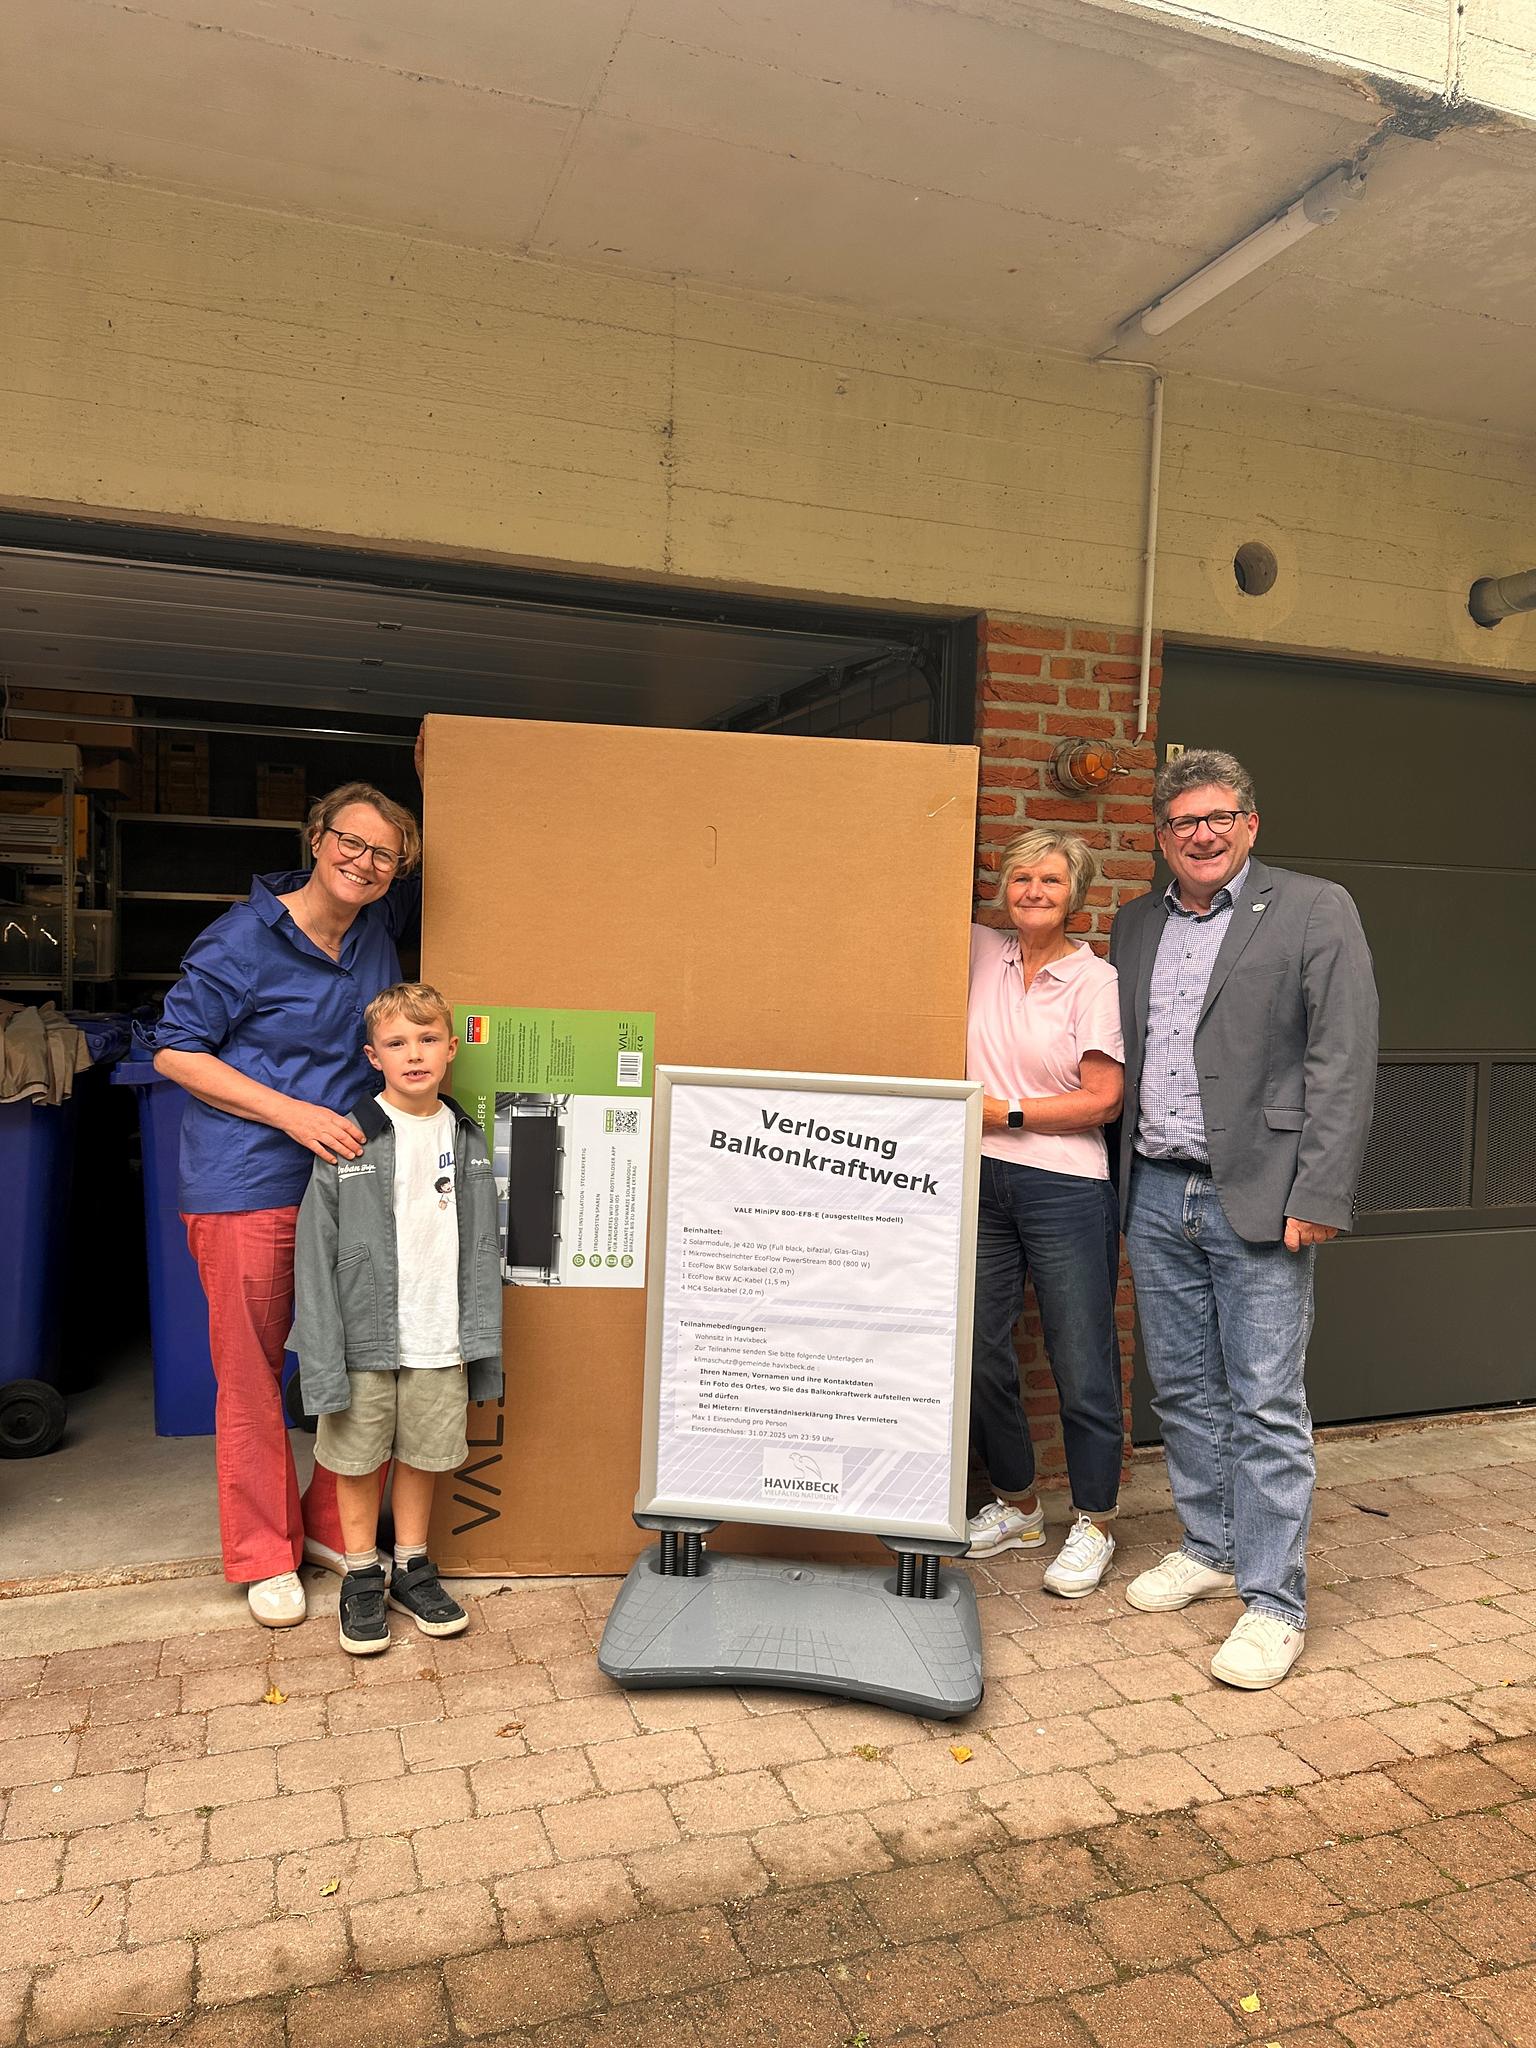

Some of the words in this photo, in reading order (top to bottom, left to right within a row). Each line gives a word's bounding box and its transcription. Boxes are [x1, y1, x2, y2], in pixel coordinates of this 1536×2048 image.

[619, 1023, 628, 1050] VALE
[762, 1109, 898, 1160] Verlosung
[710, 1129, 939, 1195] Balkonkraftwerk
[755, 1208, 779, 1216] MiniPV
[781, 1210, 819, 1218] 800-EF8-E
[822, 1213, 873, 1222] (ausgestelltes
[876, 1216, 903, 1224] Modell)
[683, 1227, 723, 1235] Beinhaltet:
[689, 1238, 732, 1248] Solarmodule,
[807, 1246, 832, 1254] bifazial,
[834, 1248, 869, 1257] Glas-Glas)
[689, 1250, 752, 1260] Mikrowechselrichter
[755, 1254, 780, 1262] EcoFlow
[783, 1256, 826, 1265] PowerStream
[843, 1260, 859, 1268] (800
[688, 1262, 714, 1270] EcoFlow
[733, 1265, 768, 1273] Solarkabel
[688, 1273, 713, 1281] EcoFlow
[733, 1276, 763, 1284] AC-Kabel
[764, 1278, 778, 1286] (1,5
[704, 1286, 737, 1294] Solarkabel
[680, 1321, 766, 1332] Teilnahmebedingungen:
[797, 1352, 825, 1360] folgende
[827, 1355, 863, 1363] Unterlagen
[722, 1370, 749, 1378] Namen,
[752, 1372, 789, 1380] Vornamen
[824, 1377, 874, 1387] Kontaktdaten
[746, 1383, 767, 1391] Ortes,
[811, 1389, 871, 1399] Balkonkraftwerk
[874, 1394, 910, 1402] aufstellen
[913, 1396, 940, 1404] werden
[712, 1404, 742, 1412] Mietern:
[744, 1407, 833, 1420] Einverständniserklärung
[857, 1416, 898, 1424] Vermieters
[713, 1416, 750, 1425] Einsendung
[692, 1426, 746, 1435] Einsendeschluss:
[748, 1430, 786, 1439] 31.07.2025
[764, 1477, 839, 1493] HAVIXBECK
